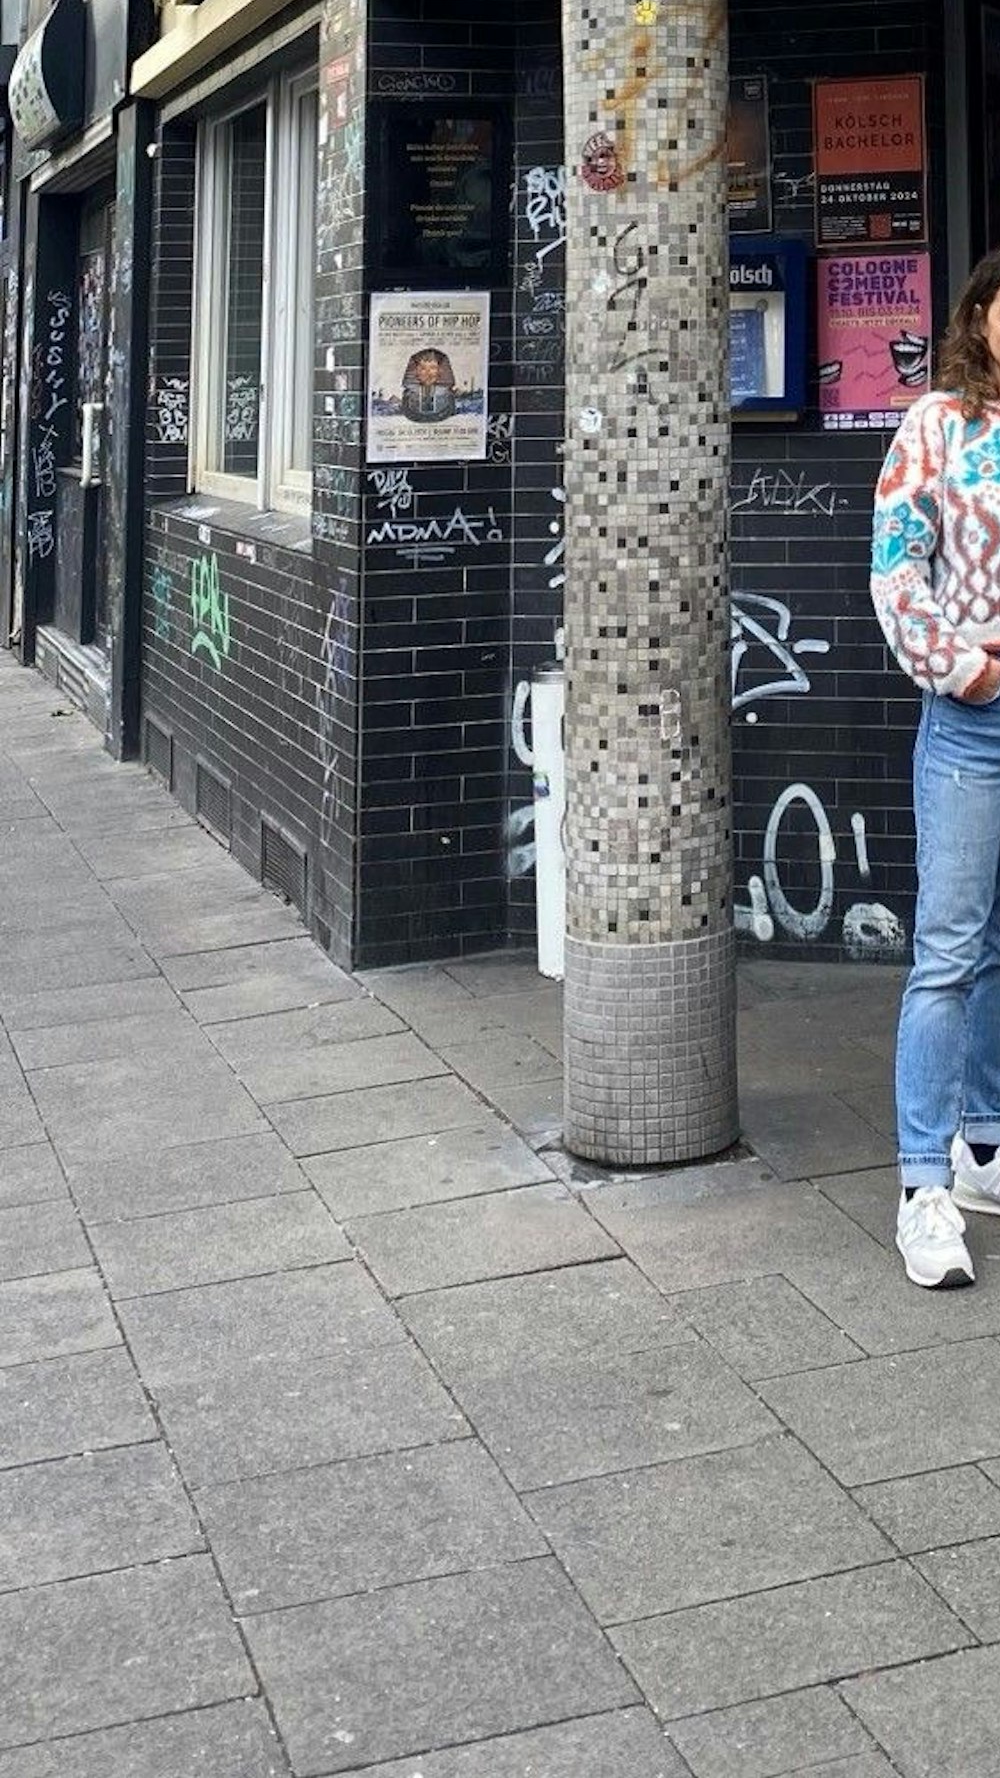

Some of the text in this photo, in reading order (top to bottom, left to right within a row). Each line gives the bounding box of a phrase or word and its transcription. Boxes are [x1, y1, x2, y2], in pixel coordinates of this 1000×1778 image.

[835, 112, 903, 130] KÖLSCH
[824, 133, 915, 150] BACHELOR
[890, 191, 919, 201] 2024
[729, 263, 773, 286] ölsch
[828, 259, 918, 276] COLOGNE
[829, 289, 921, 307] FESTIVAL
[379, 315, 481, 328] PIONEERS OF HIP HOP
